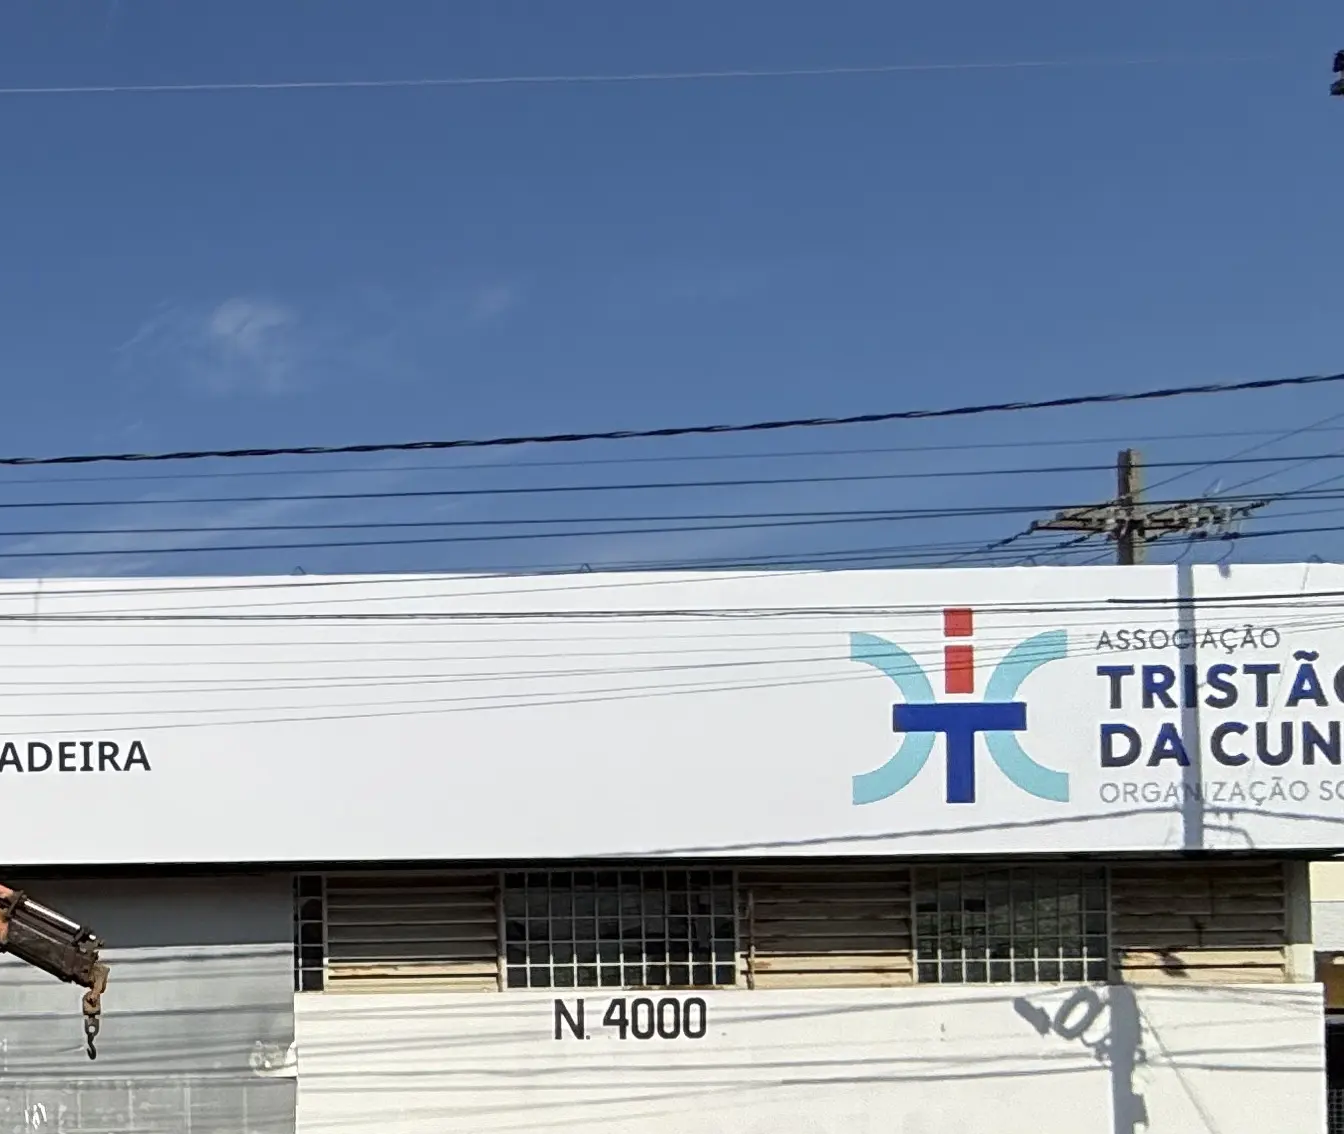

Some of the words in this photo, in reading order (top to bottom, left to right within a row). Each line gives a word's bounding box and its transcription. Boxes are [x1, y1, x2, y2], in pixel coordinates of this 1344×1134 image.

[1096, 624, 1281, 655] ASSOCIAÇÃO
[1100, 722, 1192, 768] DA
[1099, 775, 1310, 807] ORGANIZAÇÃO
[602, 996, 708, 1040] 4000
